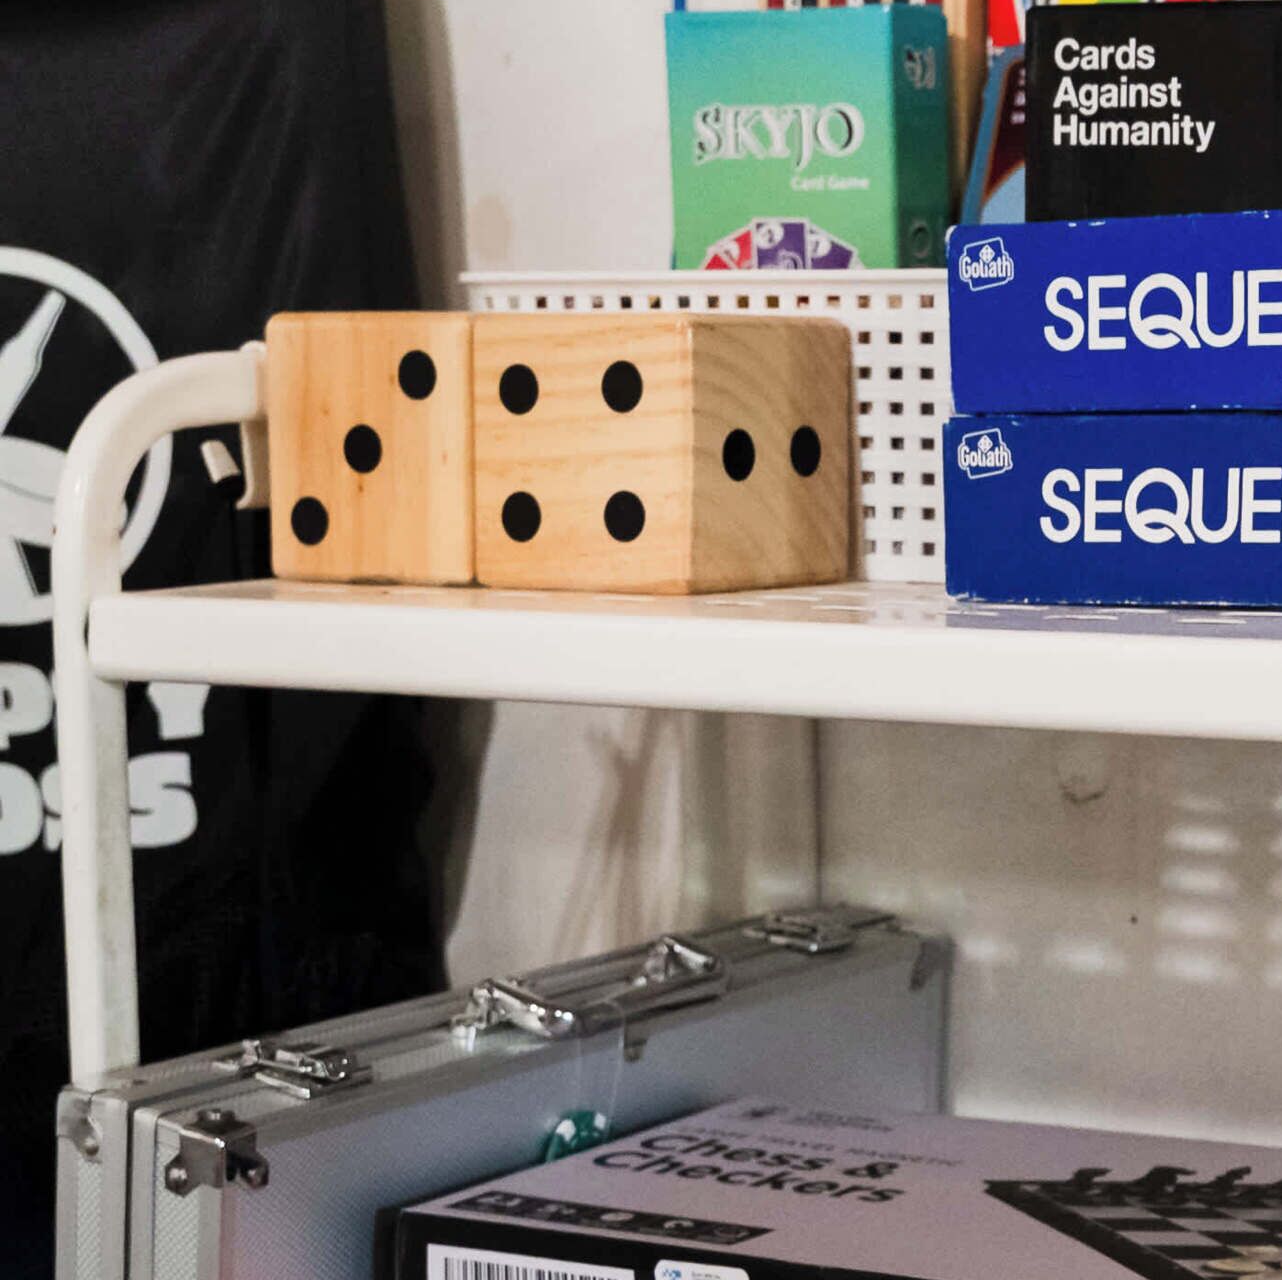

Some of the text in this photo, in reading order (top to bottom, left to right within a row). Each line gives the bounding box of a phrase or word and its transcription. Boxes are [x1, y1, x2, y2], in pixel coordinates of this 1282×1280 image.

[1054, 37, 1156, 71] Cards
[1053, 76, 1182, 117] Against
[694, 103, 865, 171] SKYJO
[1053, 114, 1216, 153] Humanity
[790, 175, 869, 191] Card Game
[960, 253, 1013, 281] Goliath
[957, 442, 1012, 472] Goliath
[641, 1133, 900, 1181] Chess &
[593, 1150, 905, 1204] Checkers
